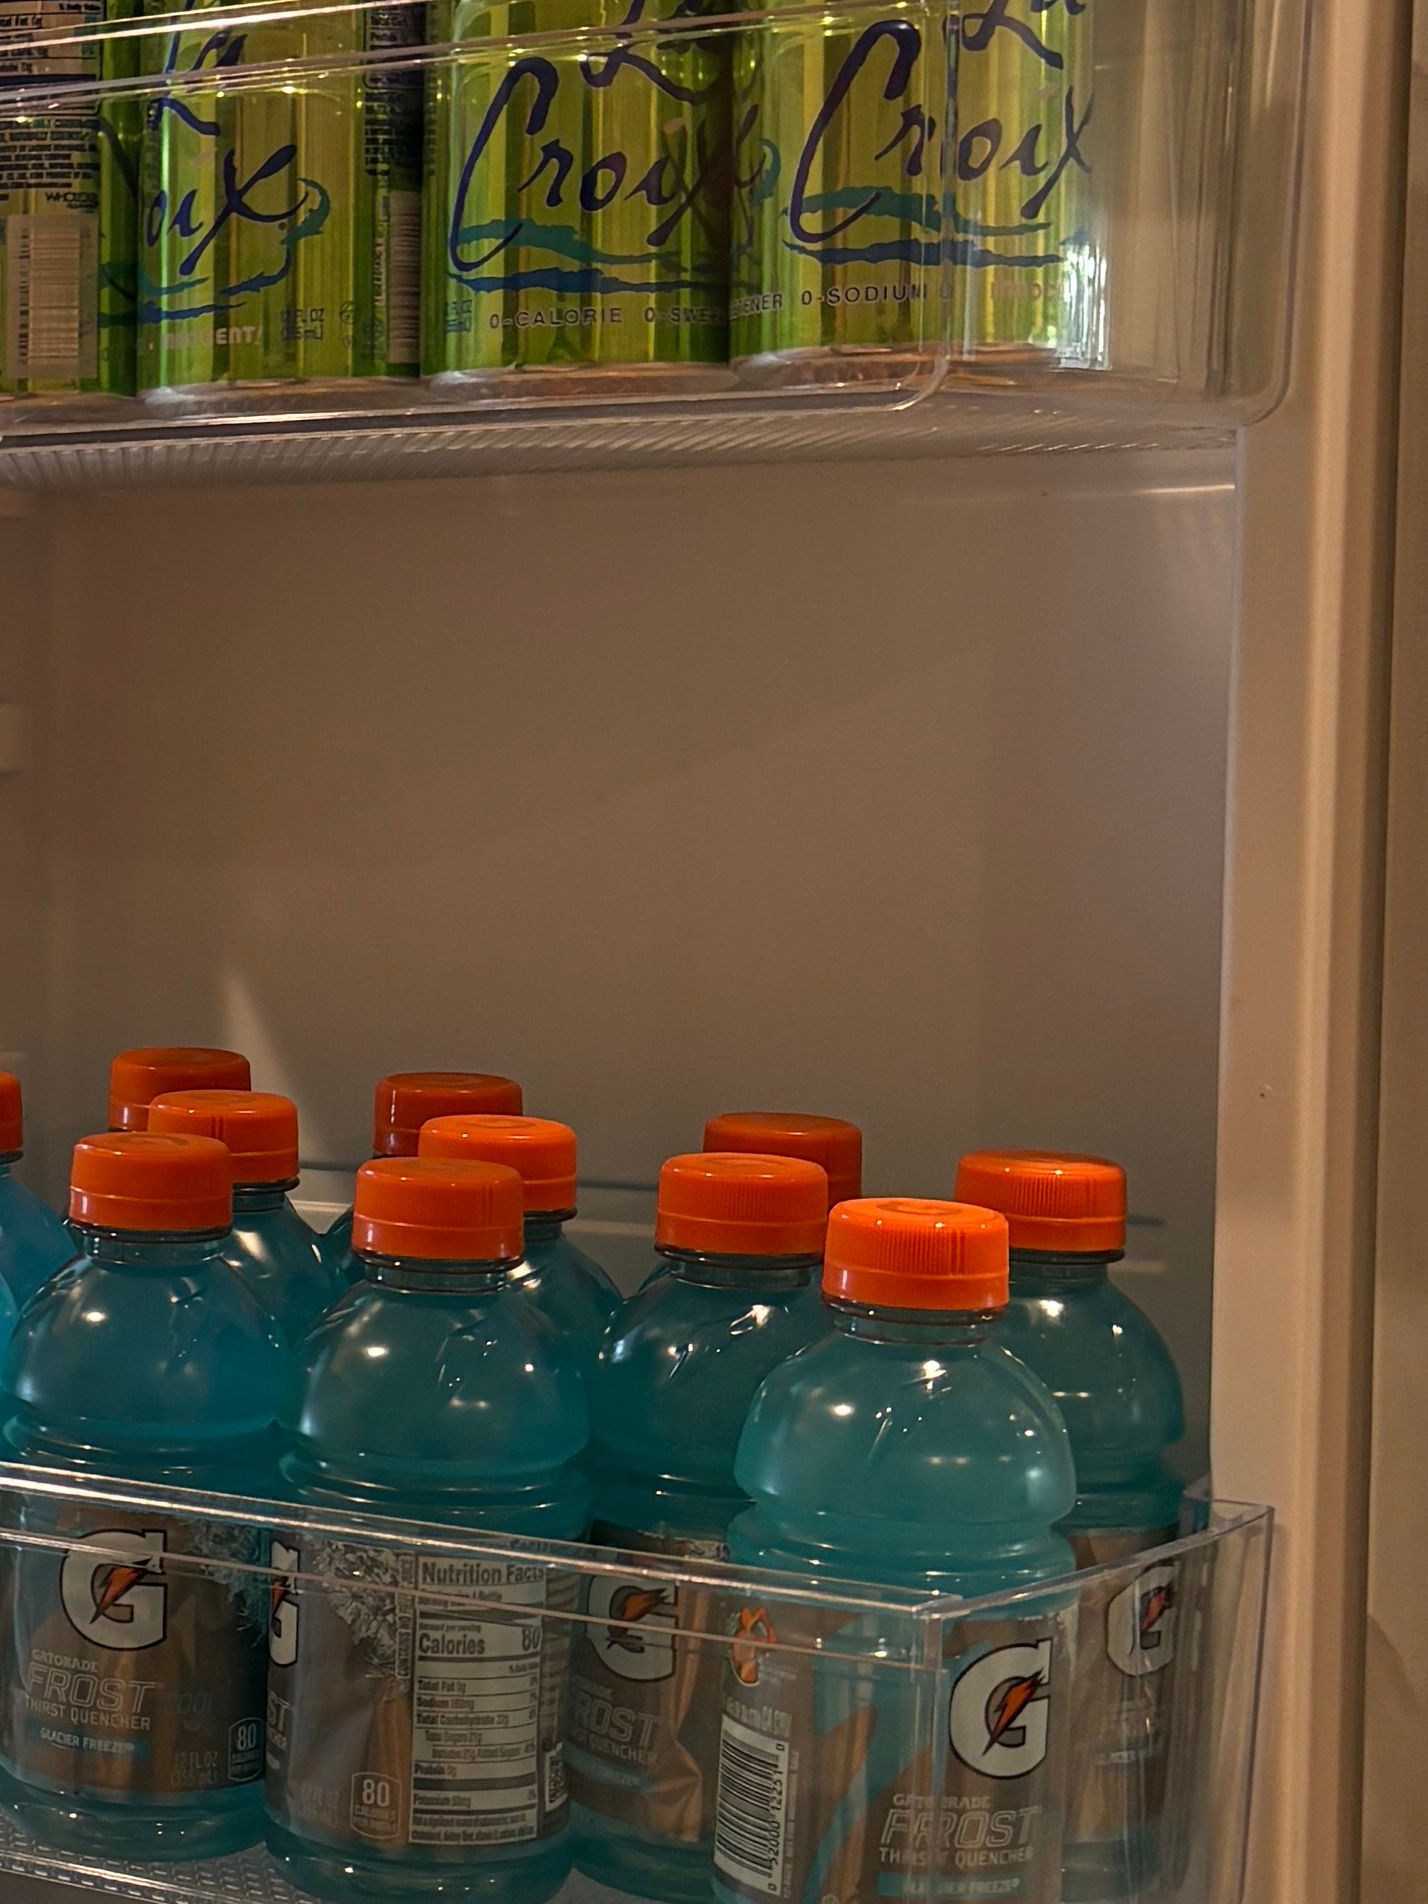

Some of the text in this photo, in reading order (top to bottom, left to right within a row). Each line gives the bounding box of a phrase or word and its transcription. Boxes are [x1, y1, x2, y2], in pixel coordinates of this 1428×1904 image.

[790, 20, 1096, 243] Croix
[489, 306, 624, 329] 0-CALORIE
[421, 1561, 502, 1585] Nutrition
[59, 1528, 168, 1651] G
[419, 1627, 541, 1656] Calories 80
[31, 1648, 99, 1673] GATORADE
[26, 1662, 157, 1715] FROST
[24, 1698, 151, 1731] THIRST QUENCHER
[949, 1637, 1053, 1780] G
[40, 1727, 80, 1747] GLACIER
[237, 1725, 257, 1751] 80
[361, 1778, 390, 1807] 80
[771, 1770, 784, 1812] 12251
[768, 1821, 781, 1865] 52000
[954, 1848, 1034, 1869] QUENCHER
